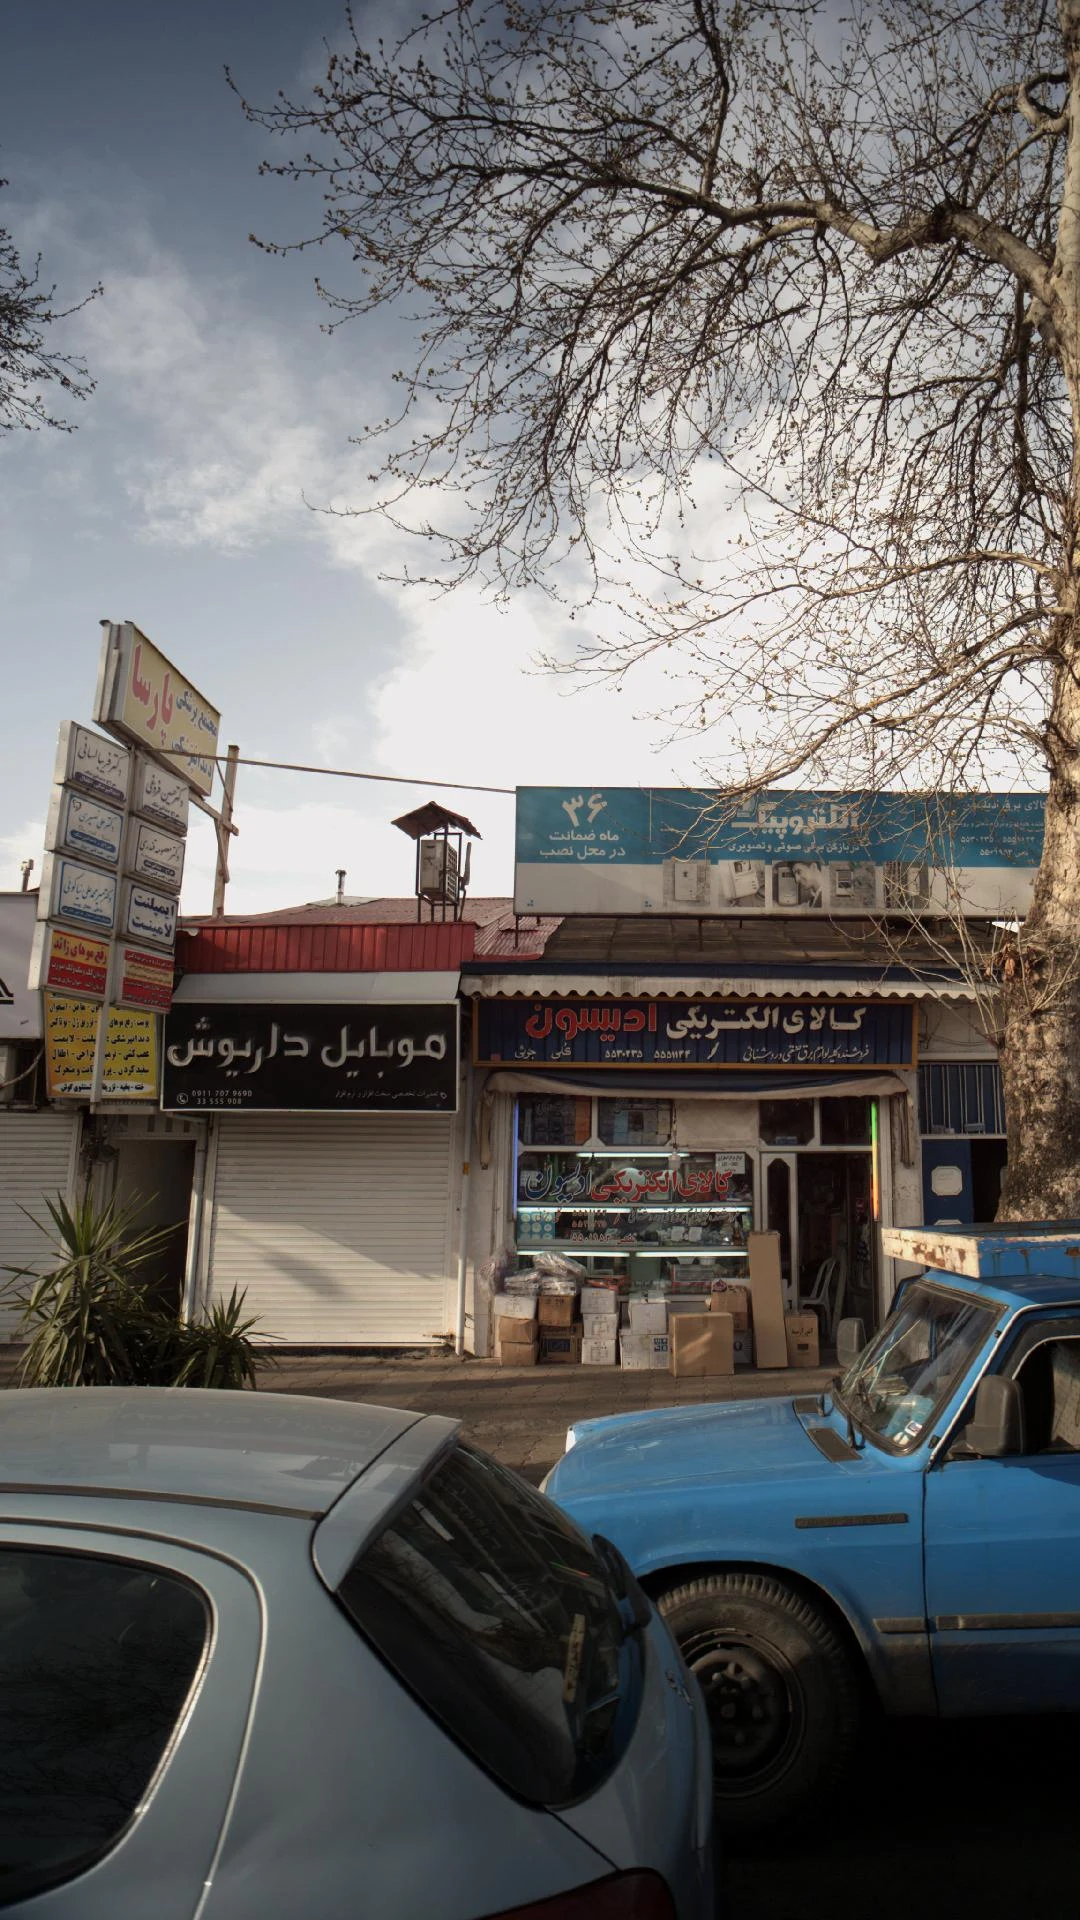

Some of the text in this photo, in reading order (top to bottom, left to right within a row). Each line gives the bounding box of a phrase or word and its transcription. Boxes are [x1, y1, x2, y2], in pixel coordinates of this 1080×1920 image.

[132, 643, 174, 746] پارسا
[561, 793, 608, 828] ۳۶
[538, 845, 627, 861] در محل نصب
[548, 829, 620, 842] ماه ضمانت
[134, 894, 174, 920] ایمپلنت
[524, 1003, 868, 1042] کالای الکتریکی ادیسون
[167, 1016, 447, 1080] موبایل داریوش
[196, 1097, 206, 1105] 33
[209, 1097, 224, 1105] 555
[525, 1162, 733, 1204] کالای الکتریکی ادیسون
